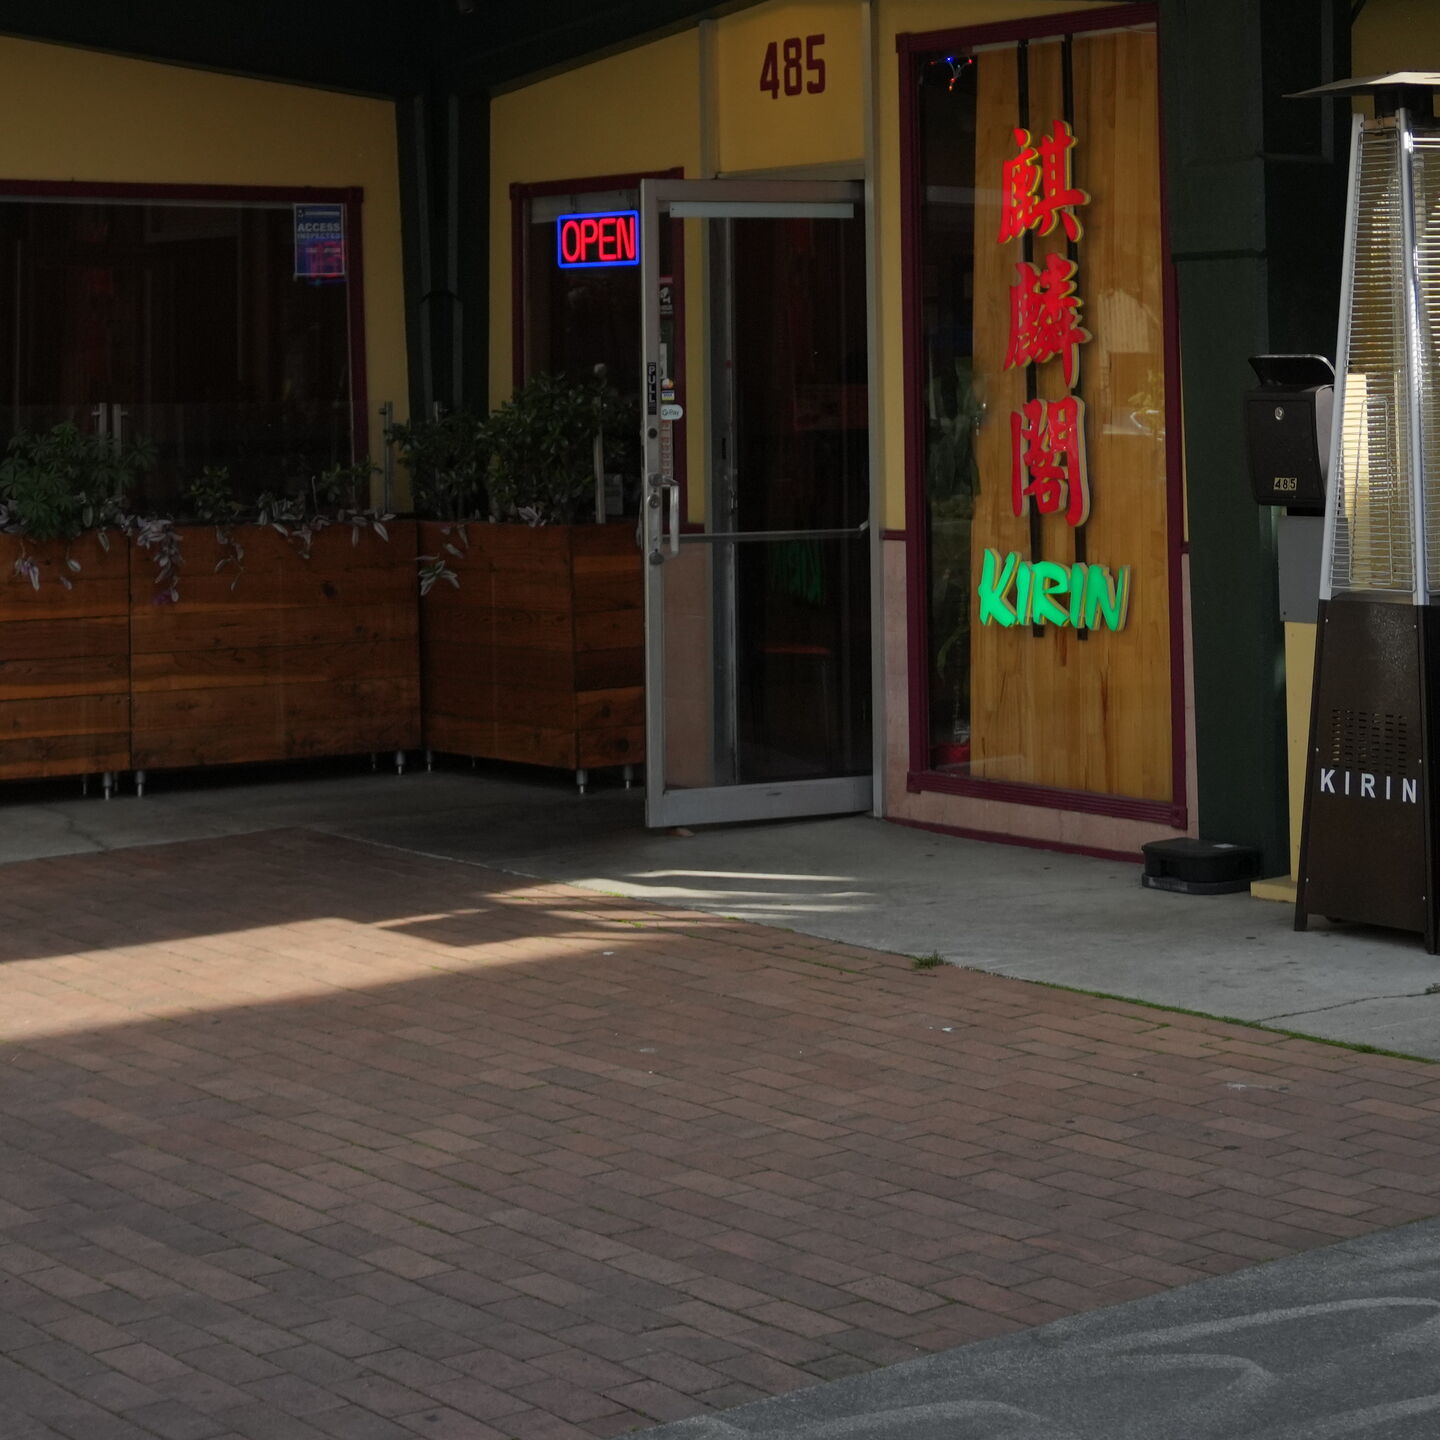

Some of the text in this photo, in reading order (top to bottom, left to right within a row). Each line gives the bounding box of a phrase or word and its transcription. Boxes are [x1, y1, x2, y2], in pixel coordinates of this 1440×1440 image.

[760, 33, 826, 100] 485
[297, 222, 340, 232] ACCESS
[562, 216, 635, 262] OPEN
[998, 120, 1091, 527] 麒麟閣
[648, 365, 656, 403] PULL
[1275, 478, 1296, 489] 485
[978, 547, 1131, 632] KIRIN
[1320, 768, 1417, 804] KIRIN
